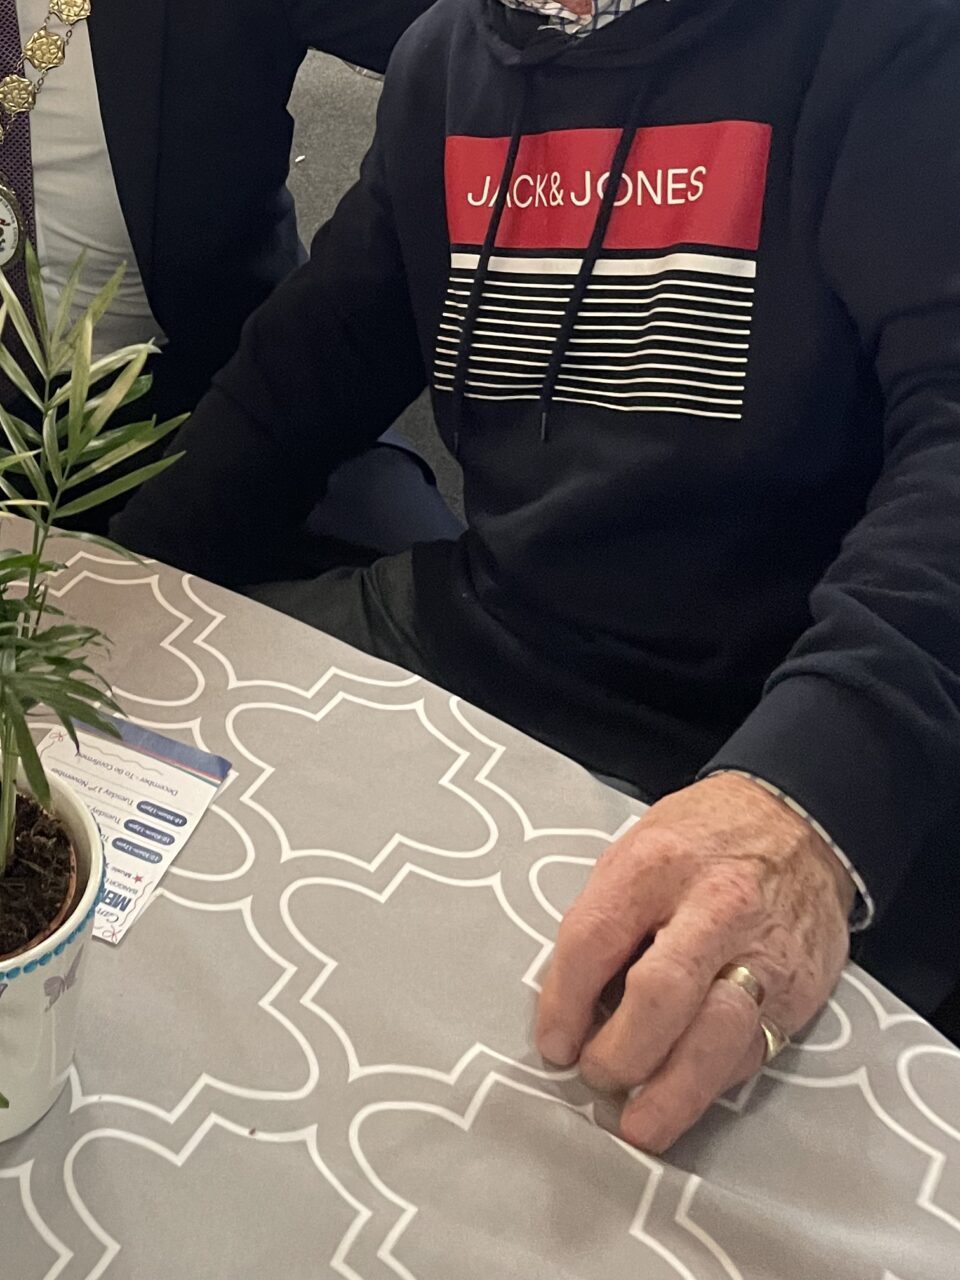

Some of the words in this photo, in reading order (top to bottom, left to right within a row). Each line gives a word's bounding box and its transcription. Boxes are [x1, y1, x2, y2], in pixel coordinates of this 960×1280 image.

[570, 166, 706, 207] JONES
[51, 766, 89, 788] November
[103, 787, 134, 806] Tuesday
[91, 806, 121, 824] Tuesday
